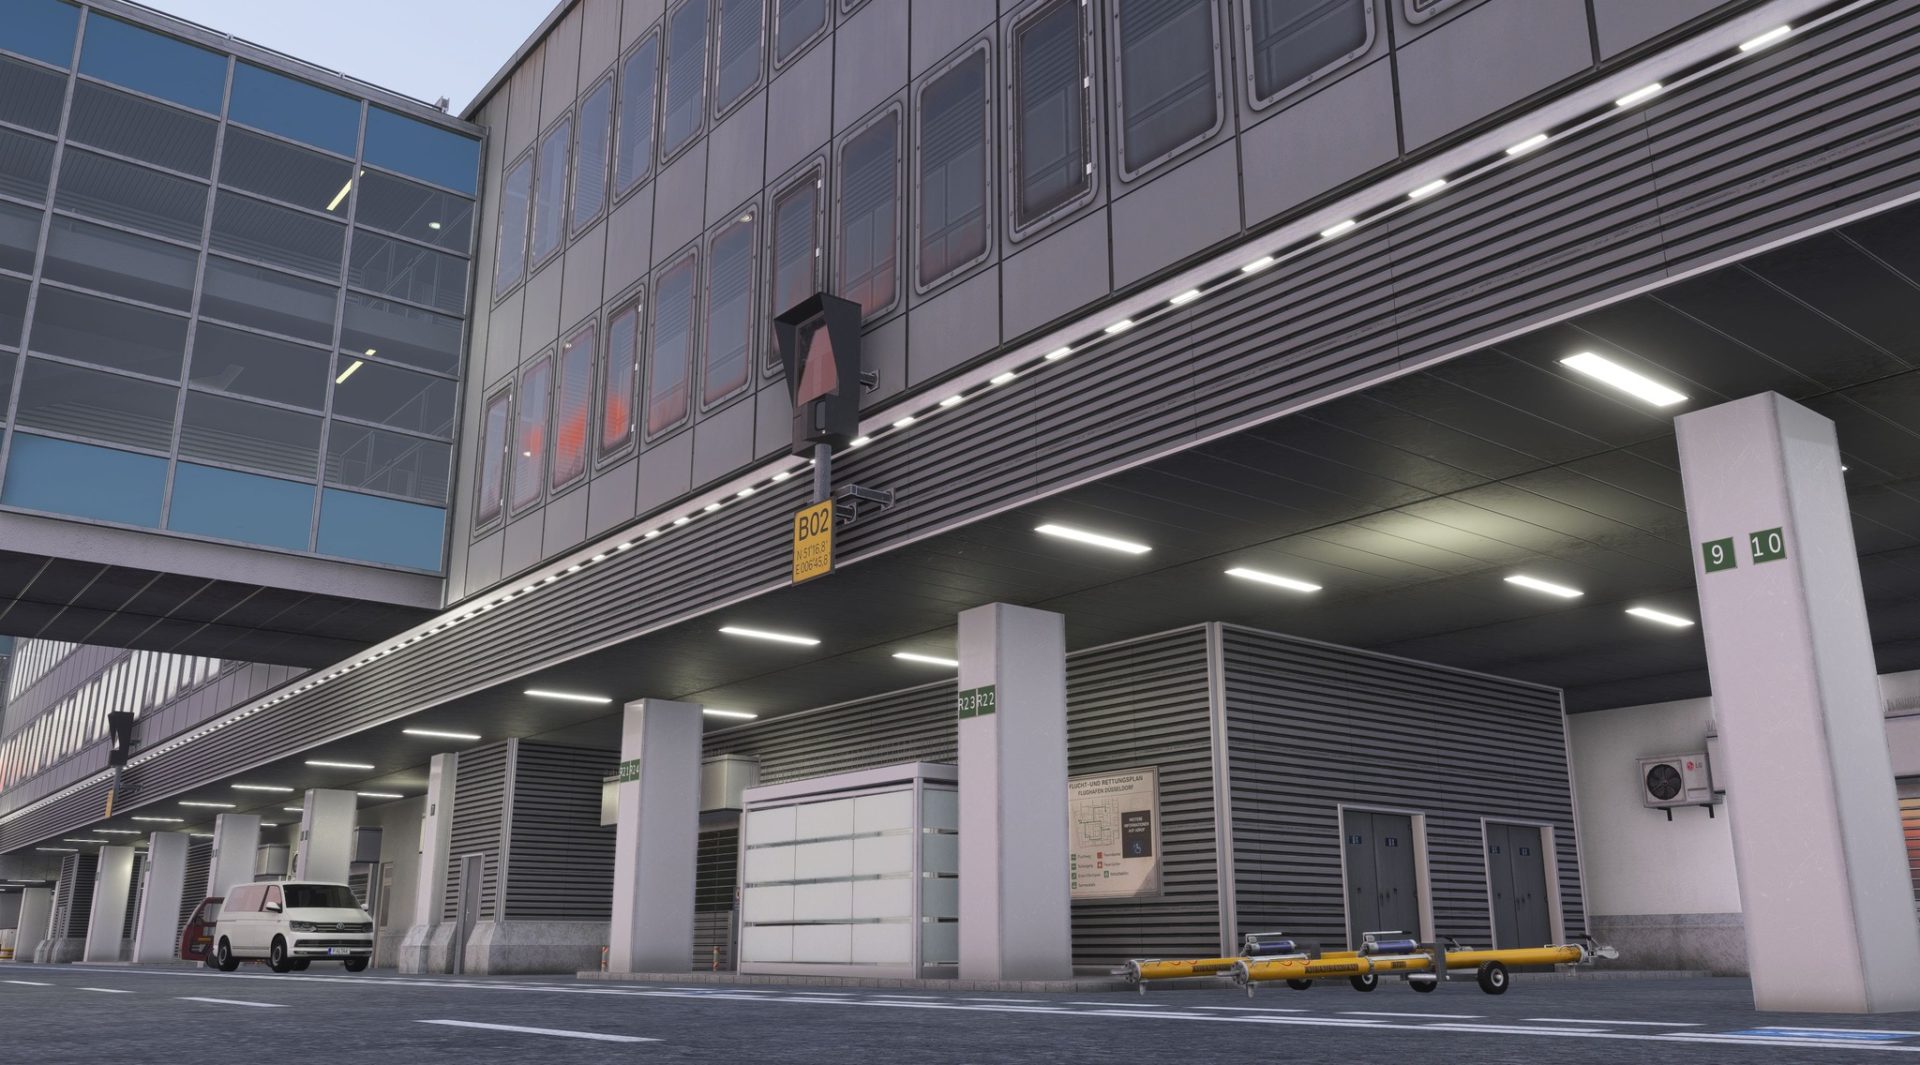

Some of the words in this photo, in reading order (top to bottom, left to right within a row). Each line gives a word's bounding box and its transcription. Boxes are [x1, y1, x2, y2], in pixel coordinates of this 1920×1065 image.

[799, 507, 829, 541] B02
[1751, 532, 1781, 557] 10
[1711, 544, 1724, 565] 9
[958, 696, 975, 710] R23
[977, 692, 994, 707] R22
[1102, 776, 1143, 785] RETTUNGSPLAN
[1077, 788, 1104, 796] FLUGHAFEN
